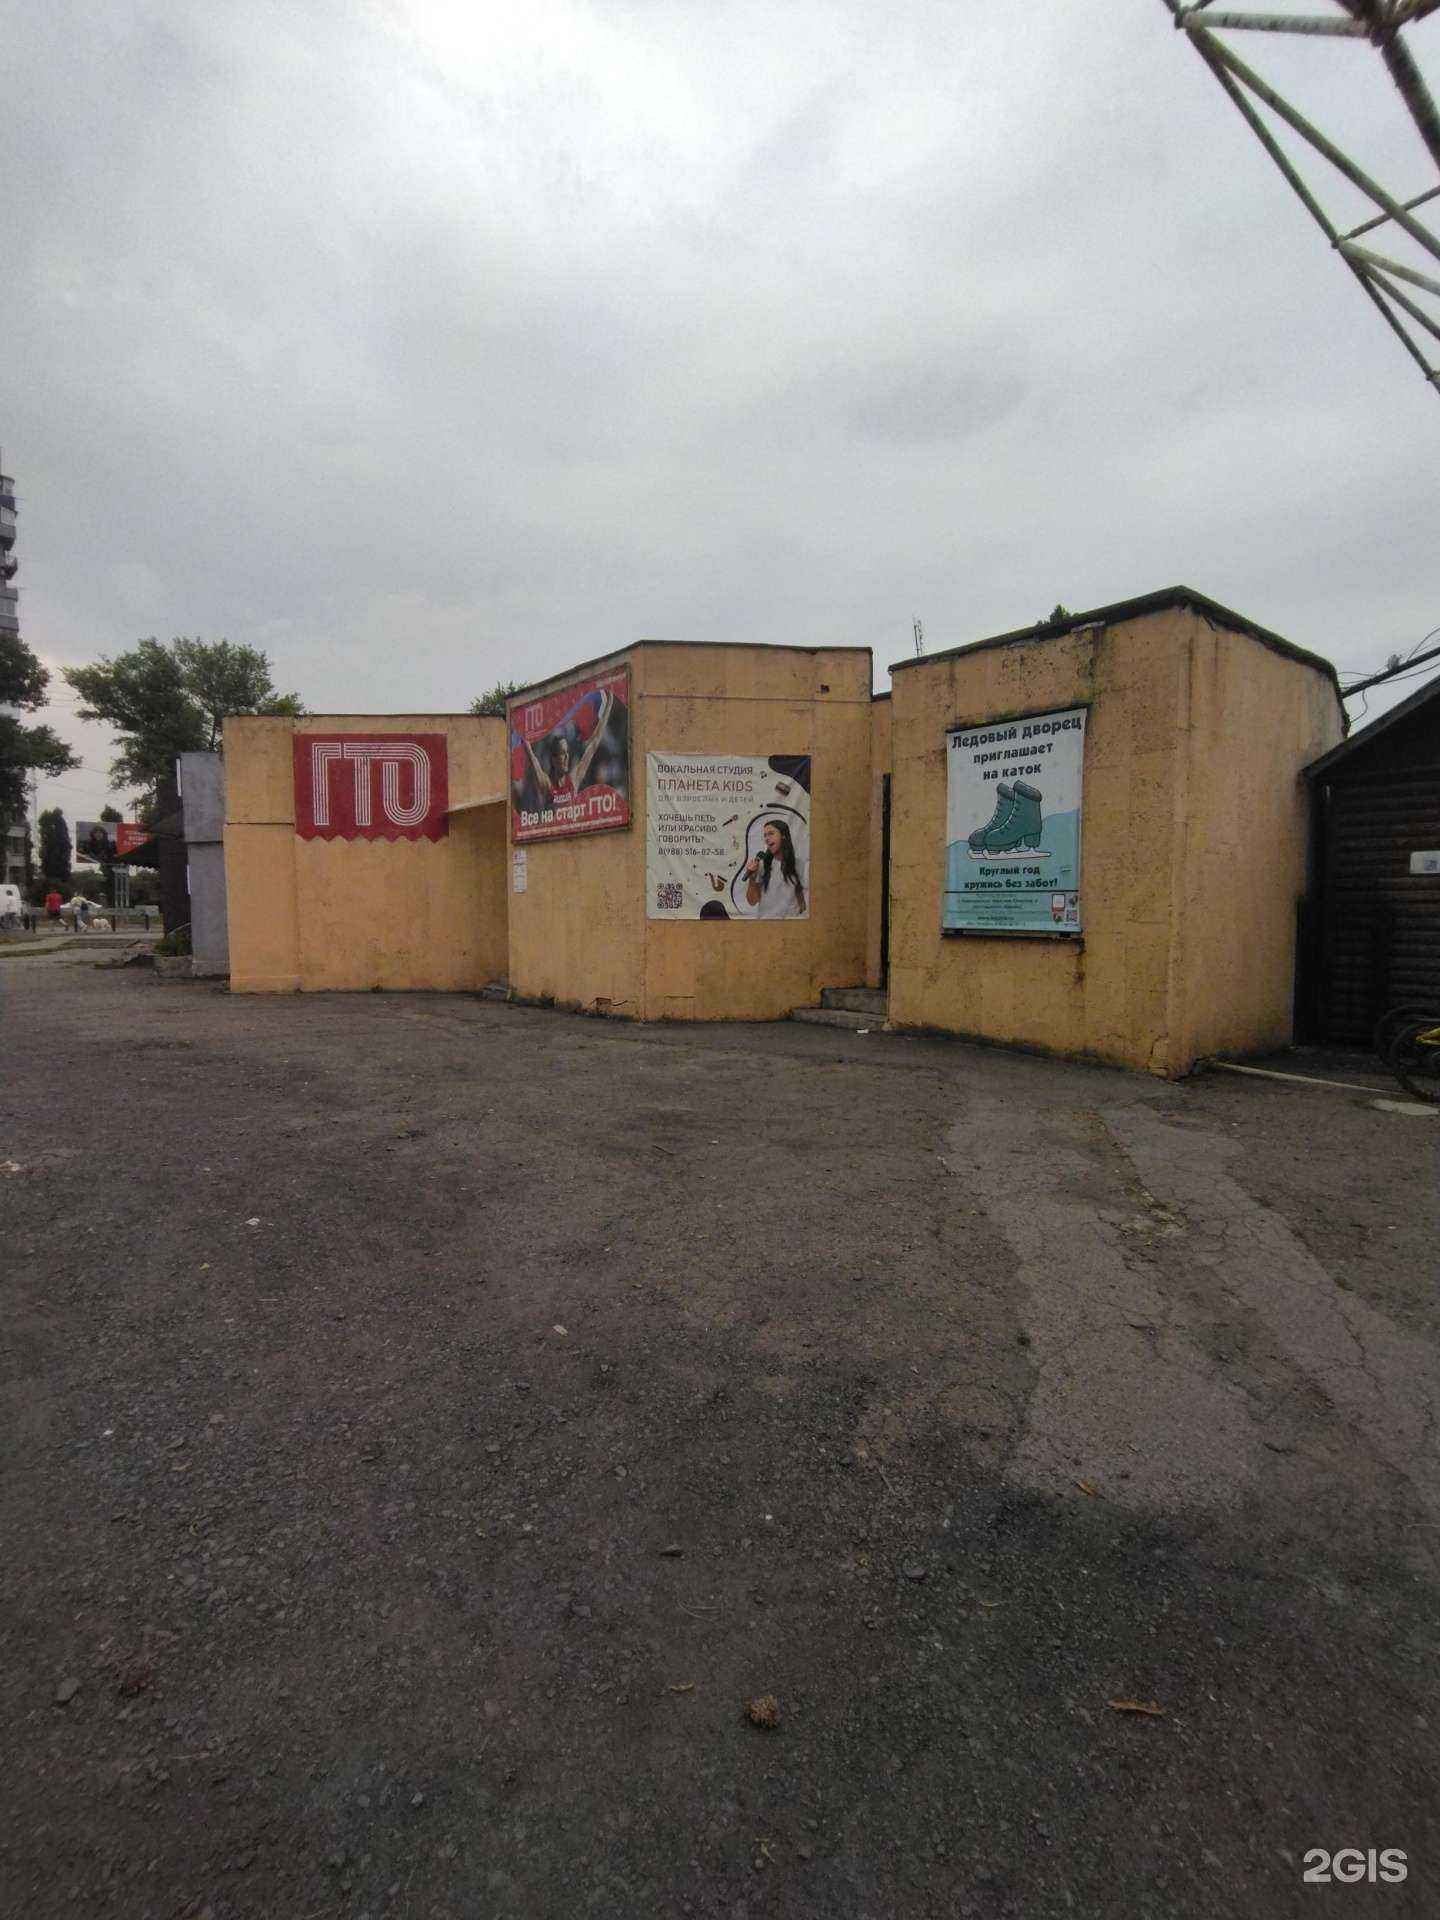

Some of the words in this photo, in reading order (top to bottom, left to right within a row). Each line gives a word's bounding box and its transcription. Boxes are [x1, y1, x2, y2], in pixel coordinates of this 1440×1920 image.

[952, 727, 1017, 748] Ледовый
[973, 743, 1053, 765] приглашает
[717, 766, 753, 776] СТУДИЯ
[983, 770, 998, 780] на
[1002, 763, 1042, 778] каток
[312, 743, 430, 825] ГТО
[657, 779, 719, 791] ПЛАНЕТА
[723, 780, 753, 792] KIDS
[521, 811, 539, 826] Все
[541, 810, 554, 823] на
[556, 803, 586, 822] старт
[588, 793, 616, 815] ГТО!
[658, 814, 693, 822] ХОЧЕШЬ
[694, 814, 716, 822] ПЕТЬ
[658, 824, 677, 832] ИЛИ
[678, 824, 718, 832] КРАСИВО
[658, 835, 705, 843] ГОВОРИТЬ?
[979, 867, 1020, 876] Круглый
[1022, 866, 1040, 876] год
[964, 881, 1003, 890] кружись
[1005, 880, 1022, 888] без
[1025, 878, 1058, 888] забот!
